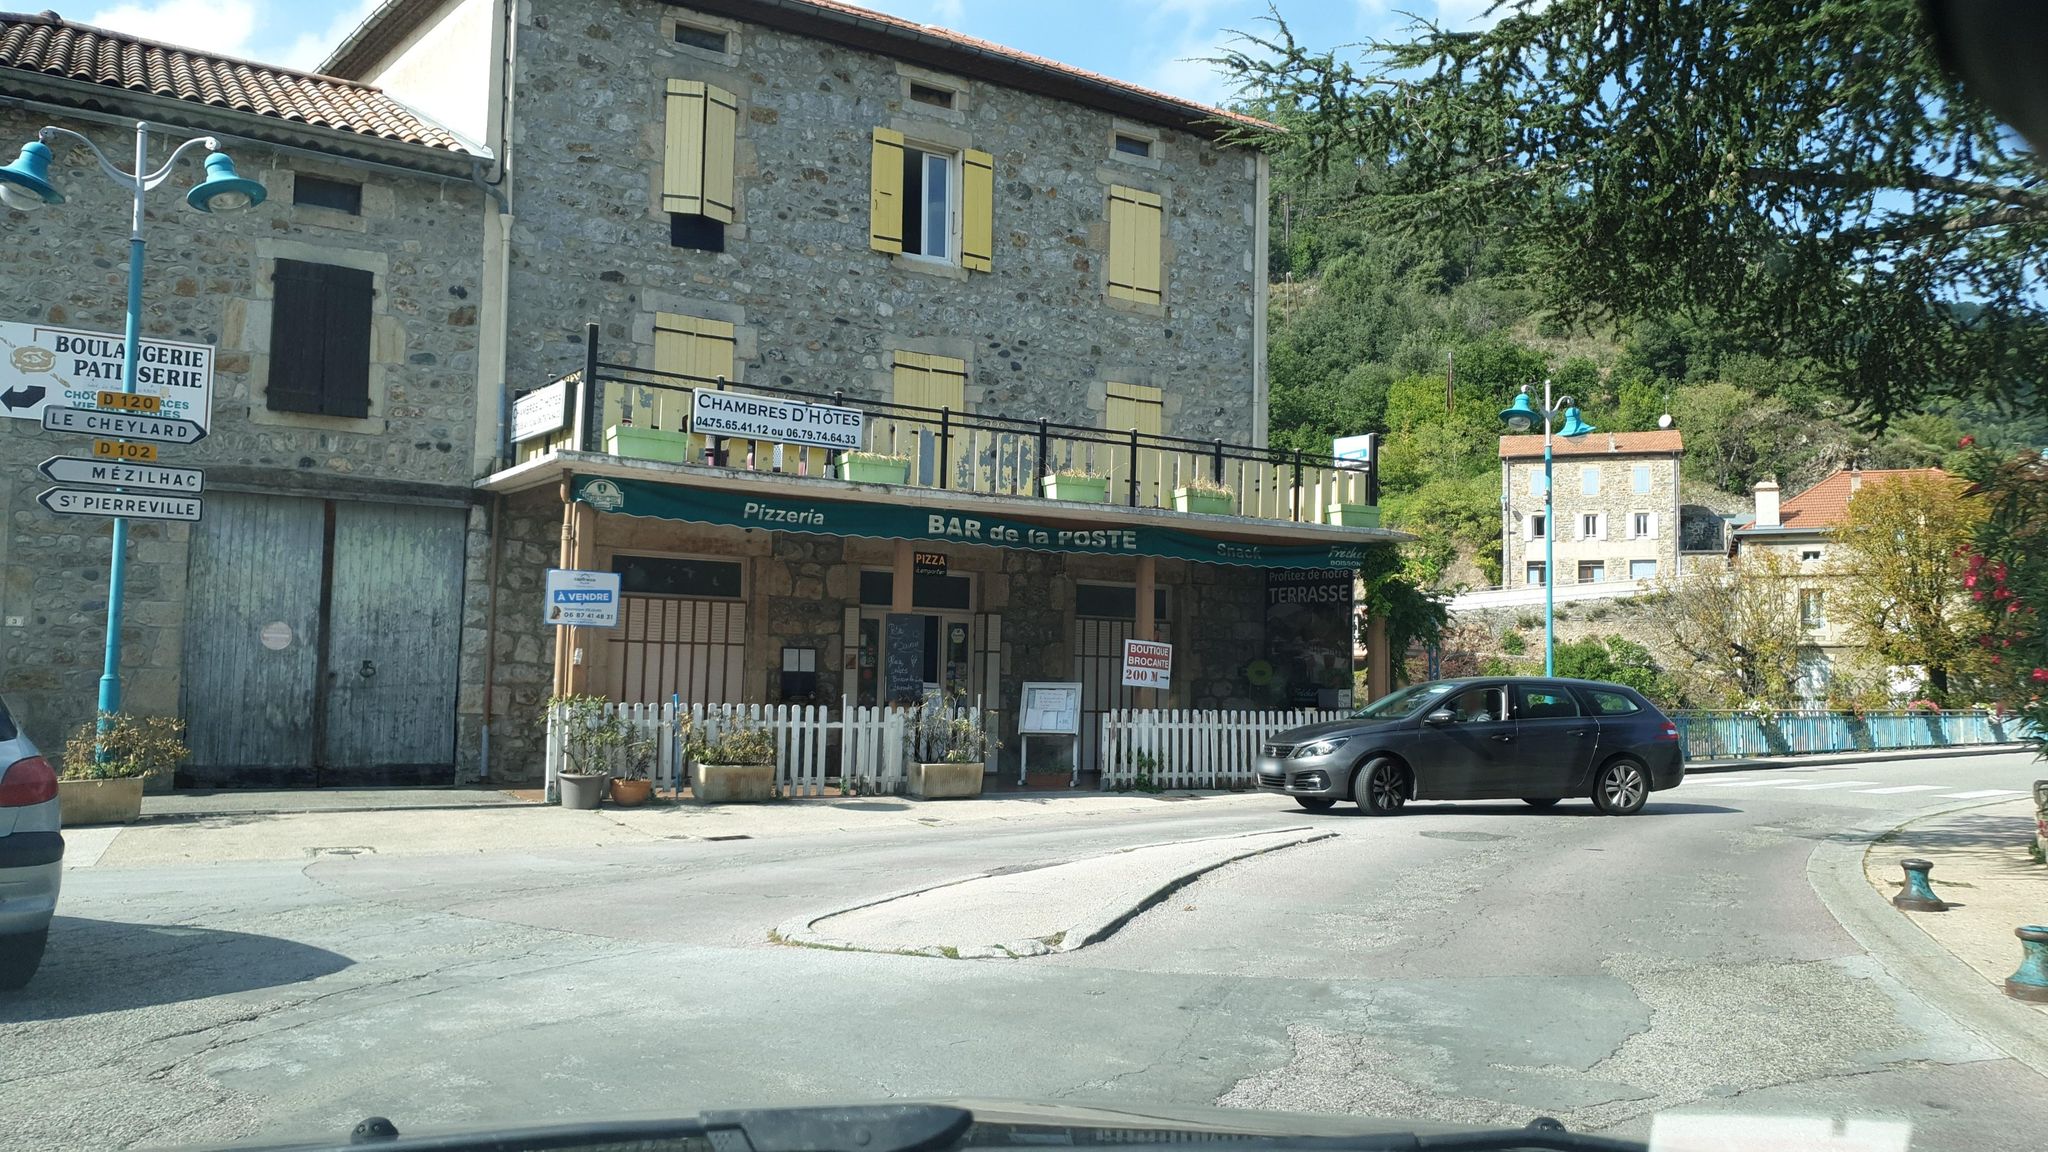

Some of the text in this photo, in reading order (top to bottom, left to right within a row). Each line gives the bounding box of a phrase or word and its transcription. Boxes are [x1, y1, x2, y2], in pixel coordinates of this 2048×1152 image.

[55, 336, 203, 368] BOULAGERIE
[74, 359, 202, 388] PATISERIE
[104, 394, 153, 409] D 120
[698, 394, 860, 427] CHAMBRES D'HÔTES
[51, 412, 188, 438] LE CHEYLARD
[696, 416, 856, 445] 04.75.65.41.12 ou 06.79.74.64.33
[100, 443, 150, 458] D 102
[92, 465, 196, 487] MÉZILHAC
[84, 496, 195, 516] PIERREVILLE
[744, 502, 825, 525] Pizzeria
[928, 514, 1137, 550] BAR de la POSTE
[916, 553, 946, 566] PIZZA
[1217, 543, 1262, 560] Snack
[1269, 569, 1349, 583] Profitez de notre
[557, 591, 609, 601] À VENDRE
[1269, 584, 1349, 604] TERRASSE
[1130, 644, 1169, 657] BOUTIQUE
[1128, 657, 1169, 669] BROCANTE
[1125, 669, 1158, 682] 200 M
